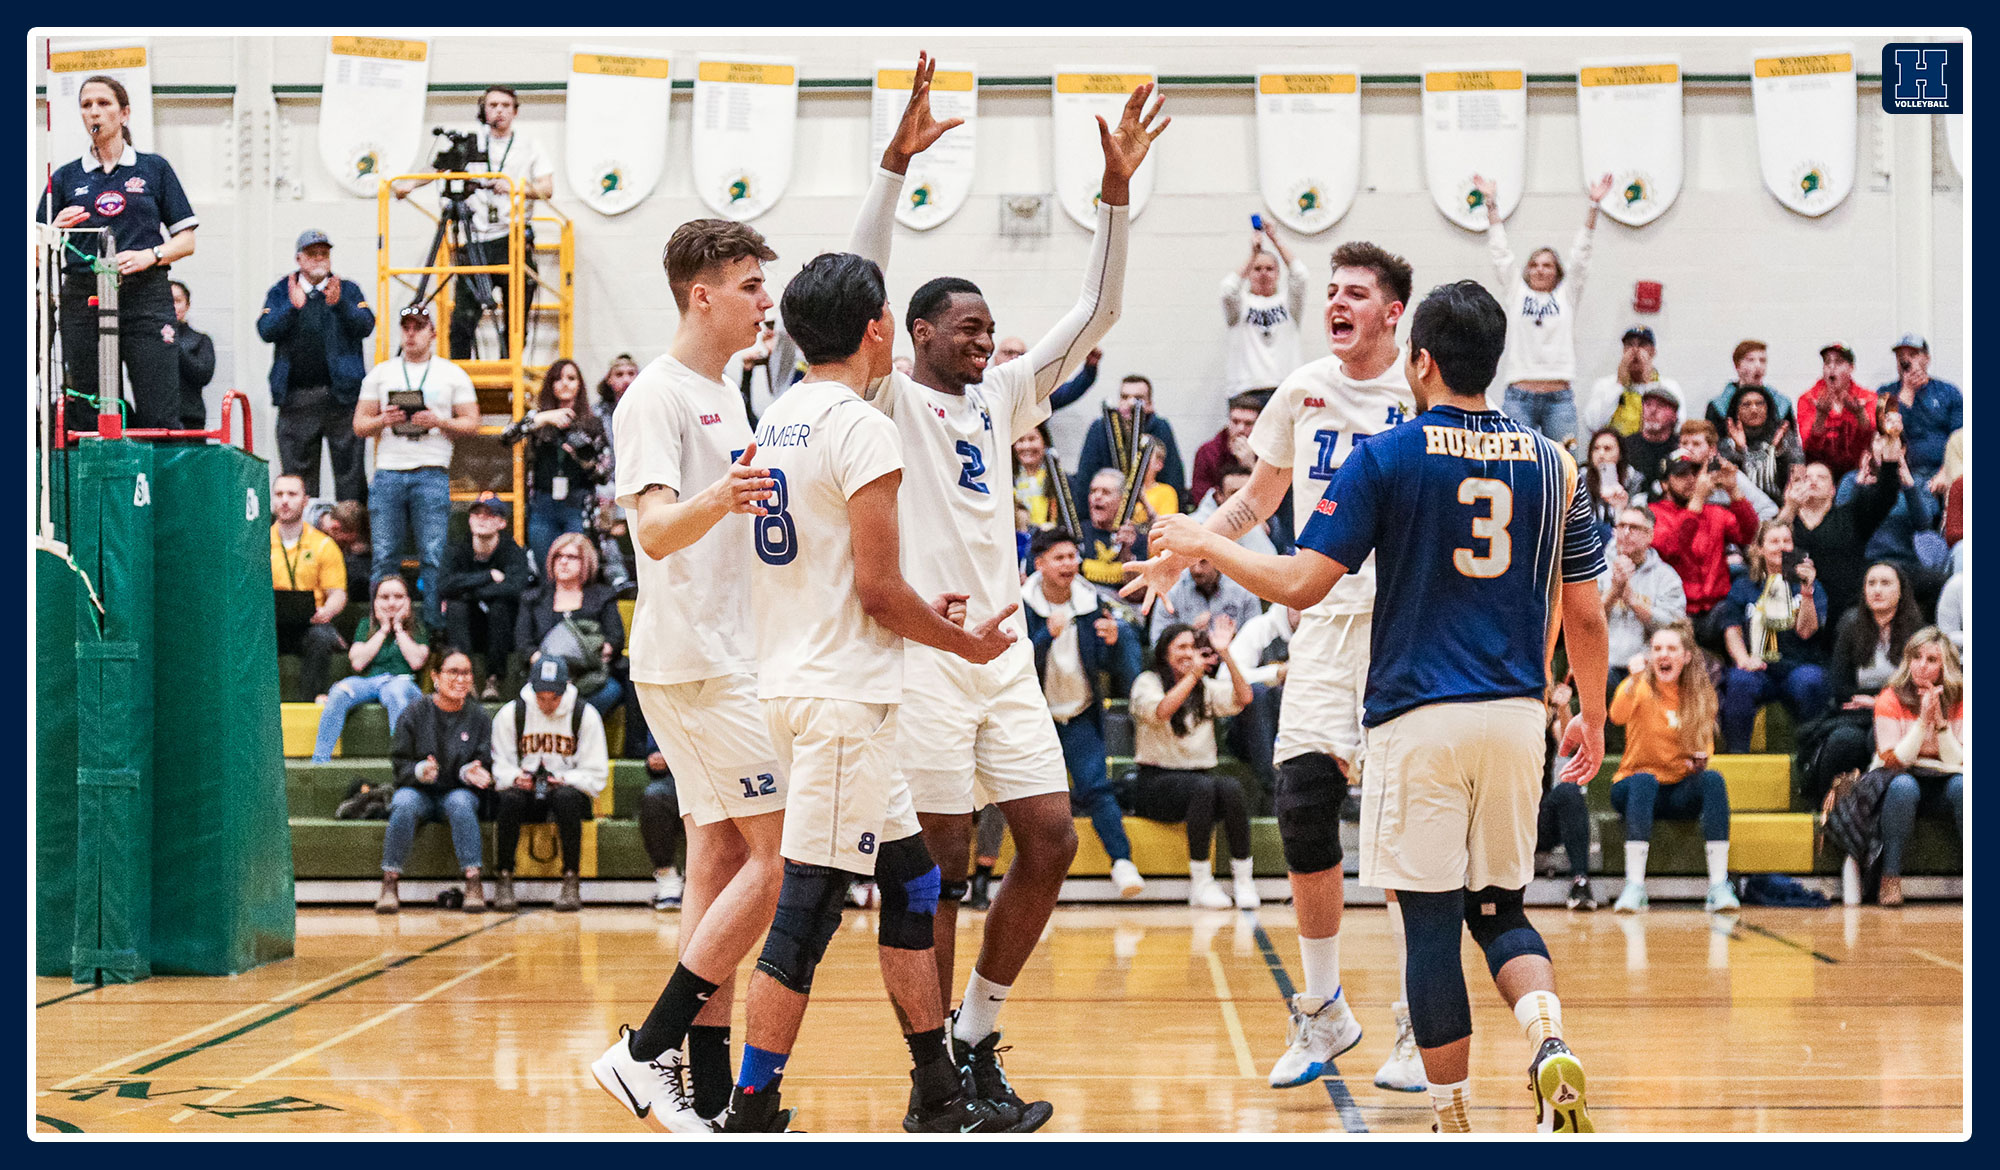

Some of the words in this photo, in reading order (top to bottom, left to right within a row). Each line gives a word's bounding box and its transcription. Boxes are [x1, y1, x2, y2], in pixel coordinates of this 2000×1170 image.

[755, 423, 811, 448] UMBER
[1308, 429, 1373, 481] 1
[1422, 425, 1537, 462] HUMBER
[955, 439, 991, 495] 2
[754, 467, 798, 566] 8
[1452, 477, 1513, 579] 3
[739, 772, 777, 798] 12
[857, 831, 876, 855] 8
